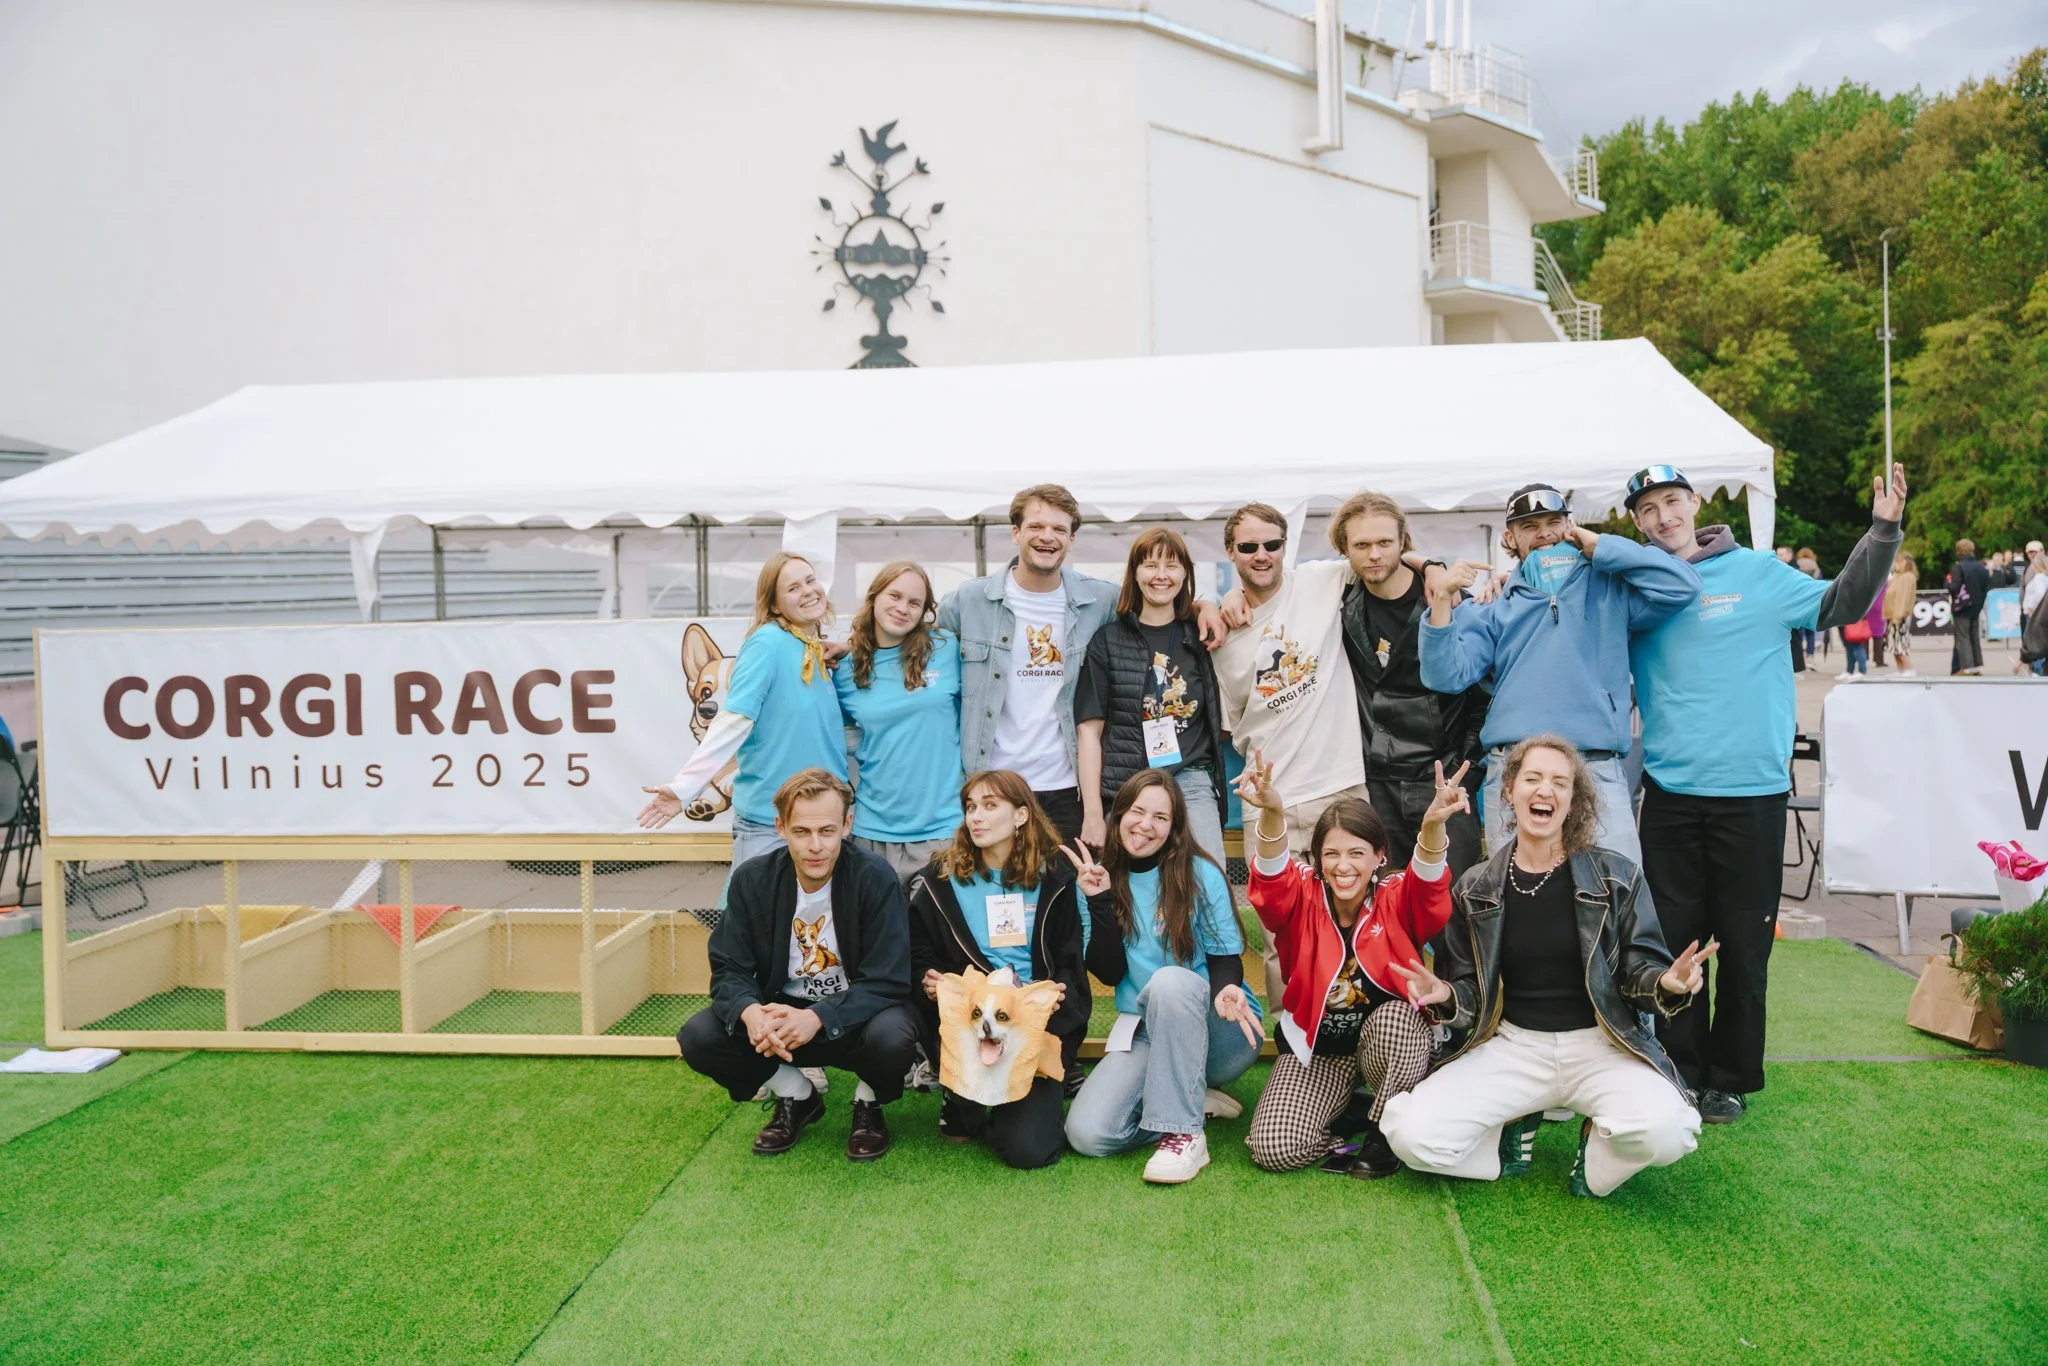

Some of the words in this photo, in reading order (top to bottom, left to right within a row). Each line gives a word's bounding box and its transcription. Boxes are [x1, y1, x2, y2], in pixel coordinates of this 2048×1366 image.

[1017, 669, 1043, 677] CORGI
[104, 673, 363, 741] CORGI
[394, 668, 616, 736] RACE
[1267, 690, 1297, 710] CORGI
[145, 754, 383, 790] Vilnius
[431, 752, 590, 788] 2025
[808, 985, 842, 996] ACE
[1324, 1012, 1363, 1021] ORGI
[1322, 1019, 1361, 1028] ACE
